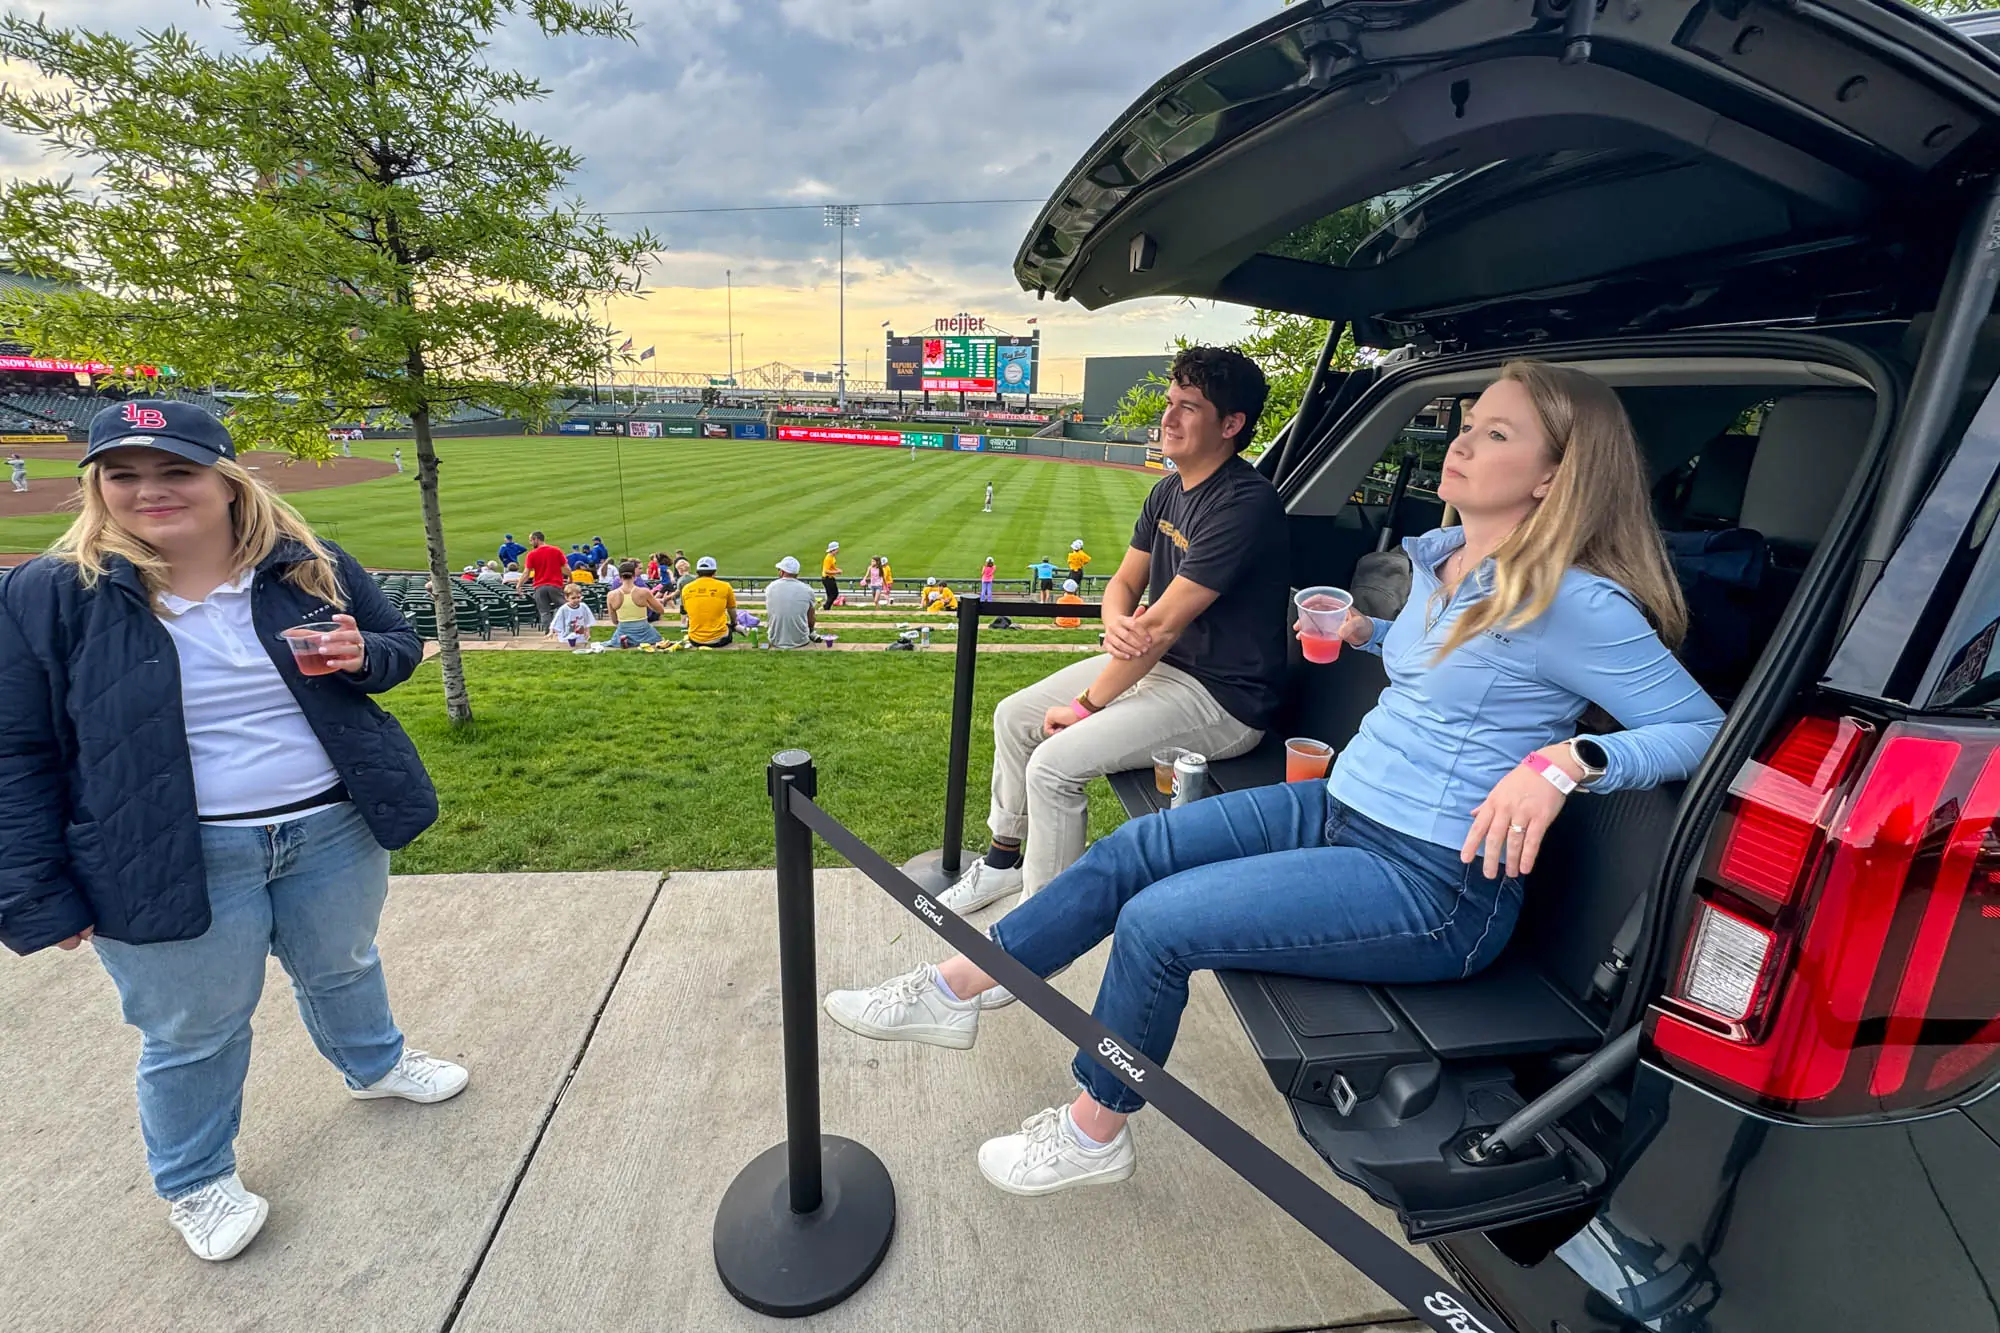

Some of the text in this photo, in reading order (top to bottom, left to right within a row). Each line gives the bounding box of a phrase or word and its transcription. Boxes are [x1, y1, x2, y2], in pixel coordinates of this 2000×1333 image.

[935, 313, 985, 334] meijer
[914, 894, 944, 927] Ford
[1098, 1037, 1144, 1082] Ford
[1424, 1291, 1495, 1333] Fo
